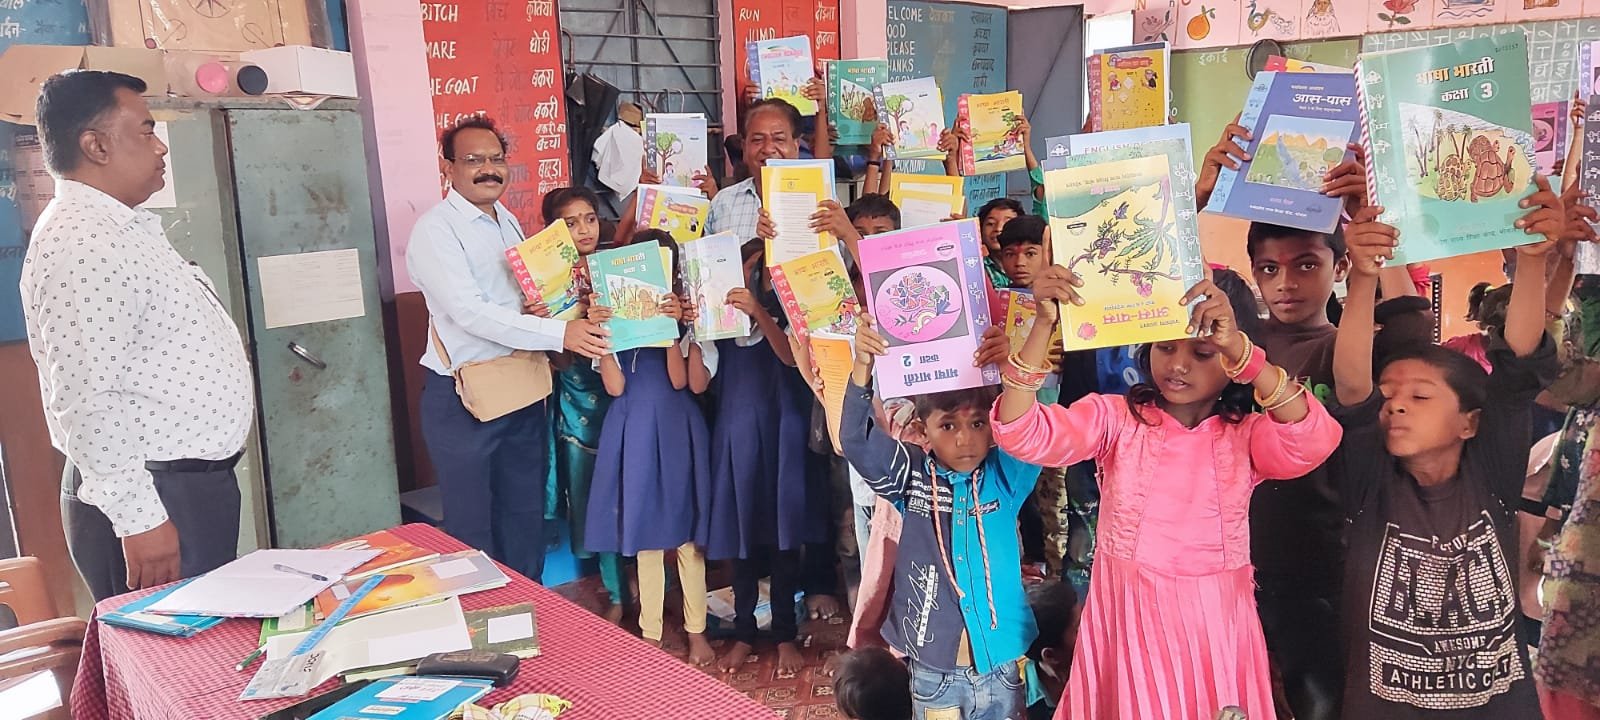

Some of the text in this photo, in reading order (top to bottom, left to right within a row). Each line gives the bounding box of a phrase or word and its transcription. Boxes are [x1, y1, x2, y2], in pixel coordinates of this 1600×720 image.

[739, 8, 761, 21] RUN
[532, 69, 555, 89] बकरा
[1416, 56, 1495, 85] भाषा भारती
[1292, 93, 1353, 107] आस-पास
[1440, 82, 1493, 102] कक्षा 3
[534, 95, 558, 120] बकरी
[640, 264, 647, 272] 3
[902, 355, 912, 367] 2
[903, 367, 959, 387] भाषा भारती
[1434, 635, 1487, 653] AWESOME
[1445, 652, 1476, 672] NYC
[1390, 669, 1477, 689] ATHLETIC
